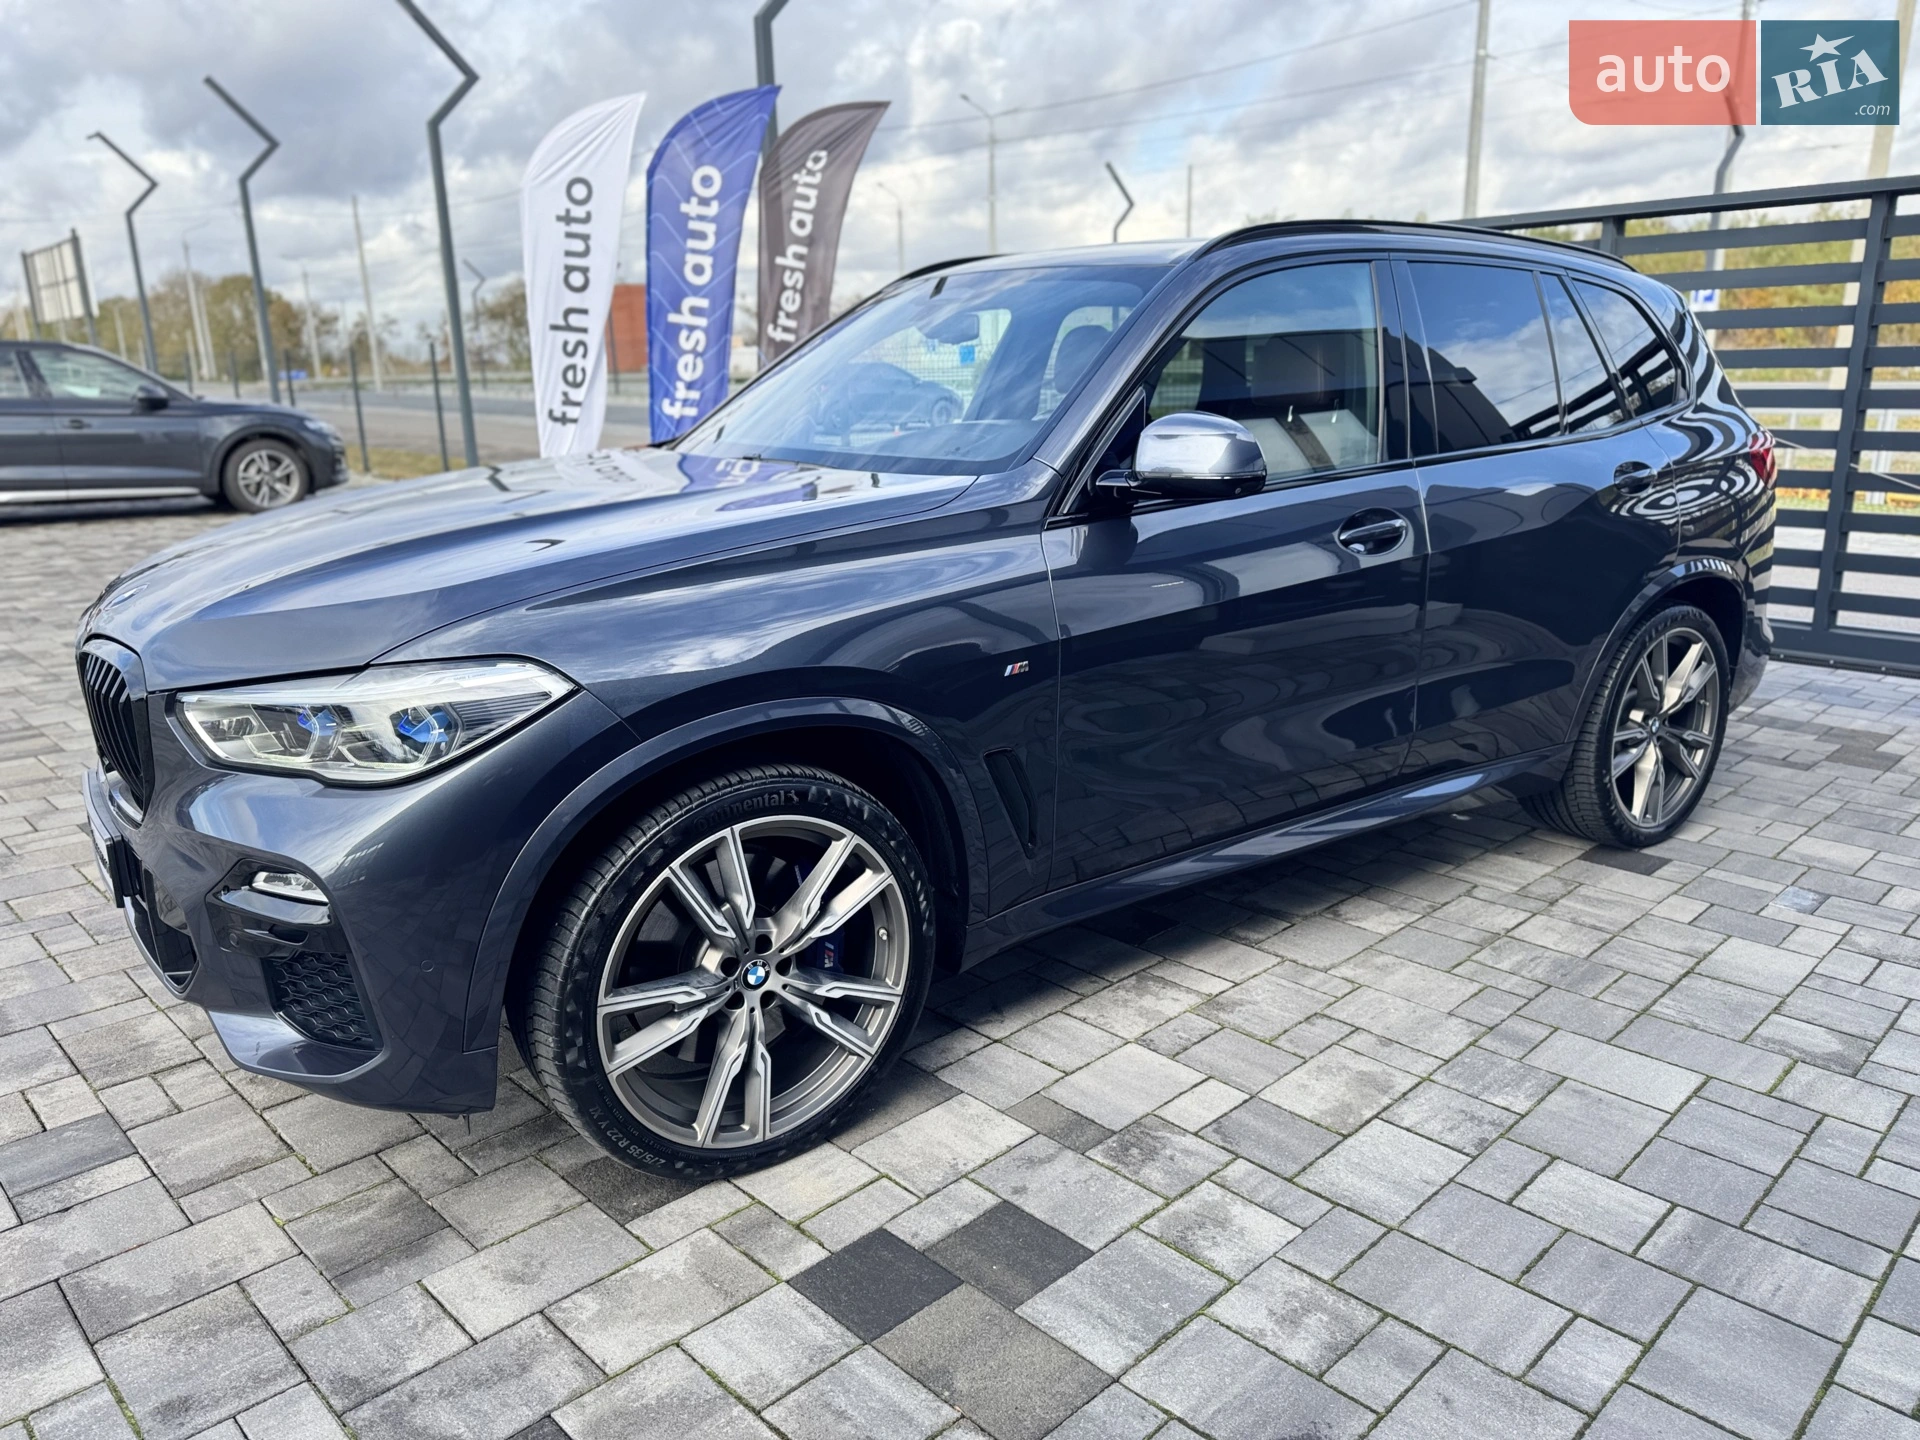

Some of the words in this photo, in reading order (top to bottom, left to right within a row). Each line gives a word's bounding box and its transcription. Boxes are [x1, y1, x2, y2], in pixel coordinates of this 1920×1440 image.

[556, 176, 593, 293] auto
[680, 165, 722, 286] auto
[767, 249, 807, 344] fresh
[789, 149, 828, 238] auto
[548, 306, 590, 426] fresh
[662, 297, 709, 419] fresh
